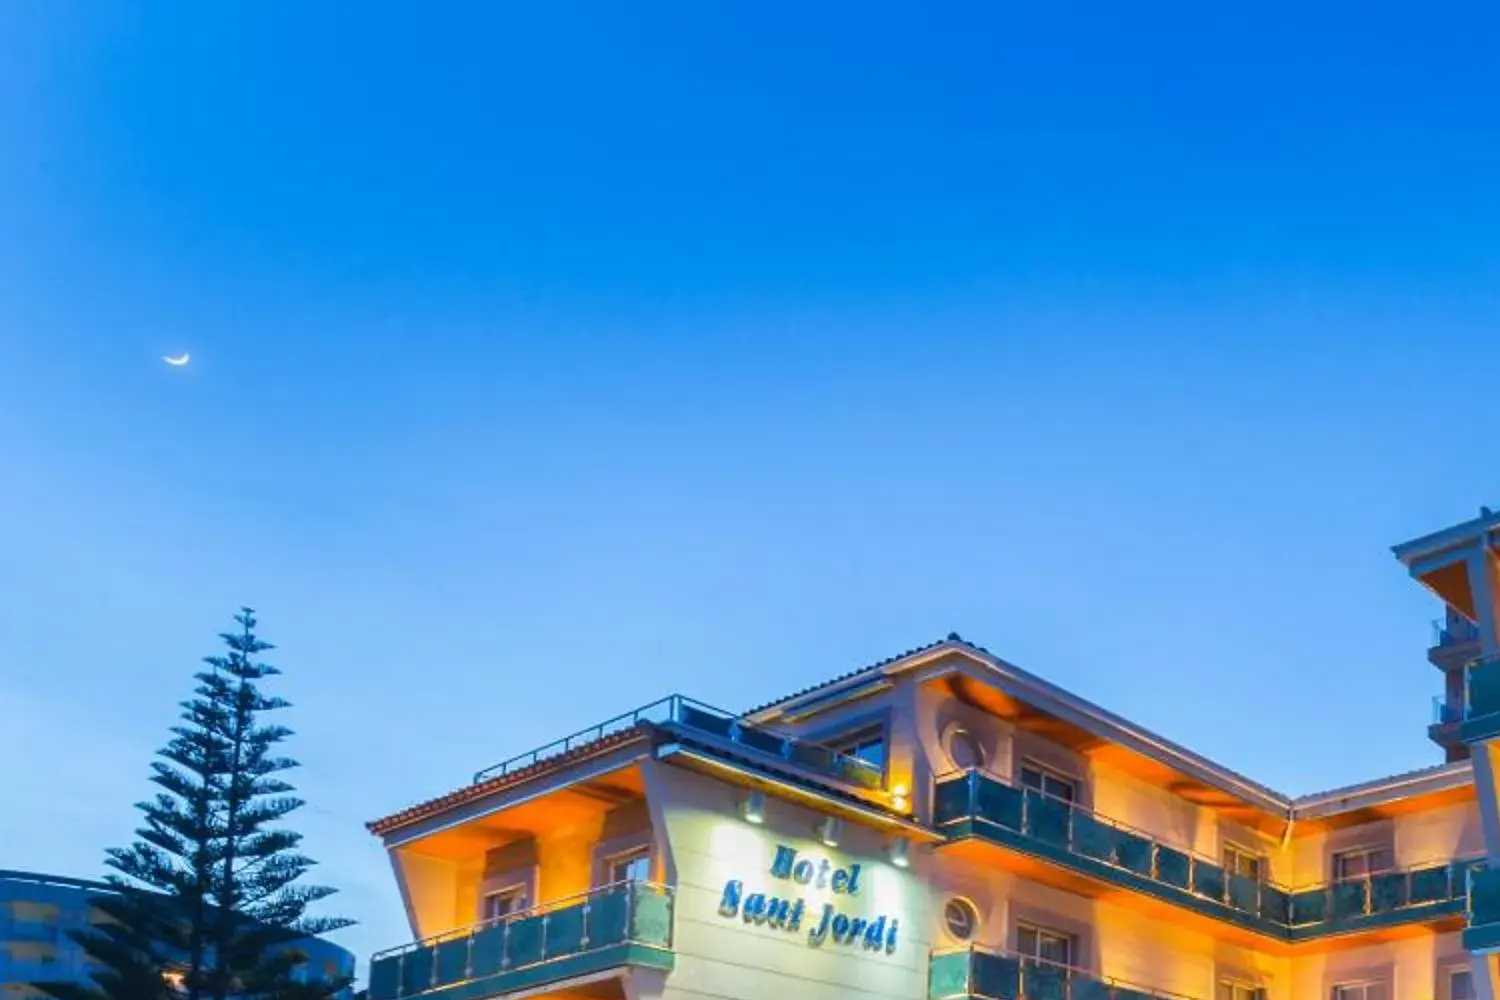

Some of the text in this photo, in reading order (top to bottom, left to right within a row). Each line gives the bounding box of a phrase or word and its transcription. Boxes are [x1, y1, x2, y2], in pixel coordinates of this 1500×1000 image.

[770, 844, 862, 896] Hotel
[718, 879, 898, 955] Sant Jordi
